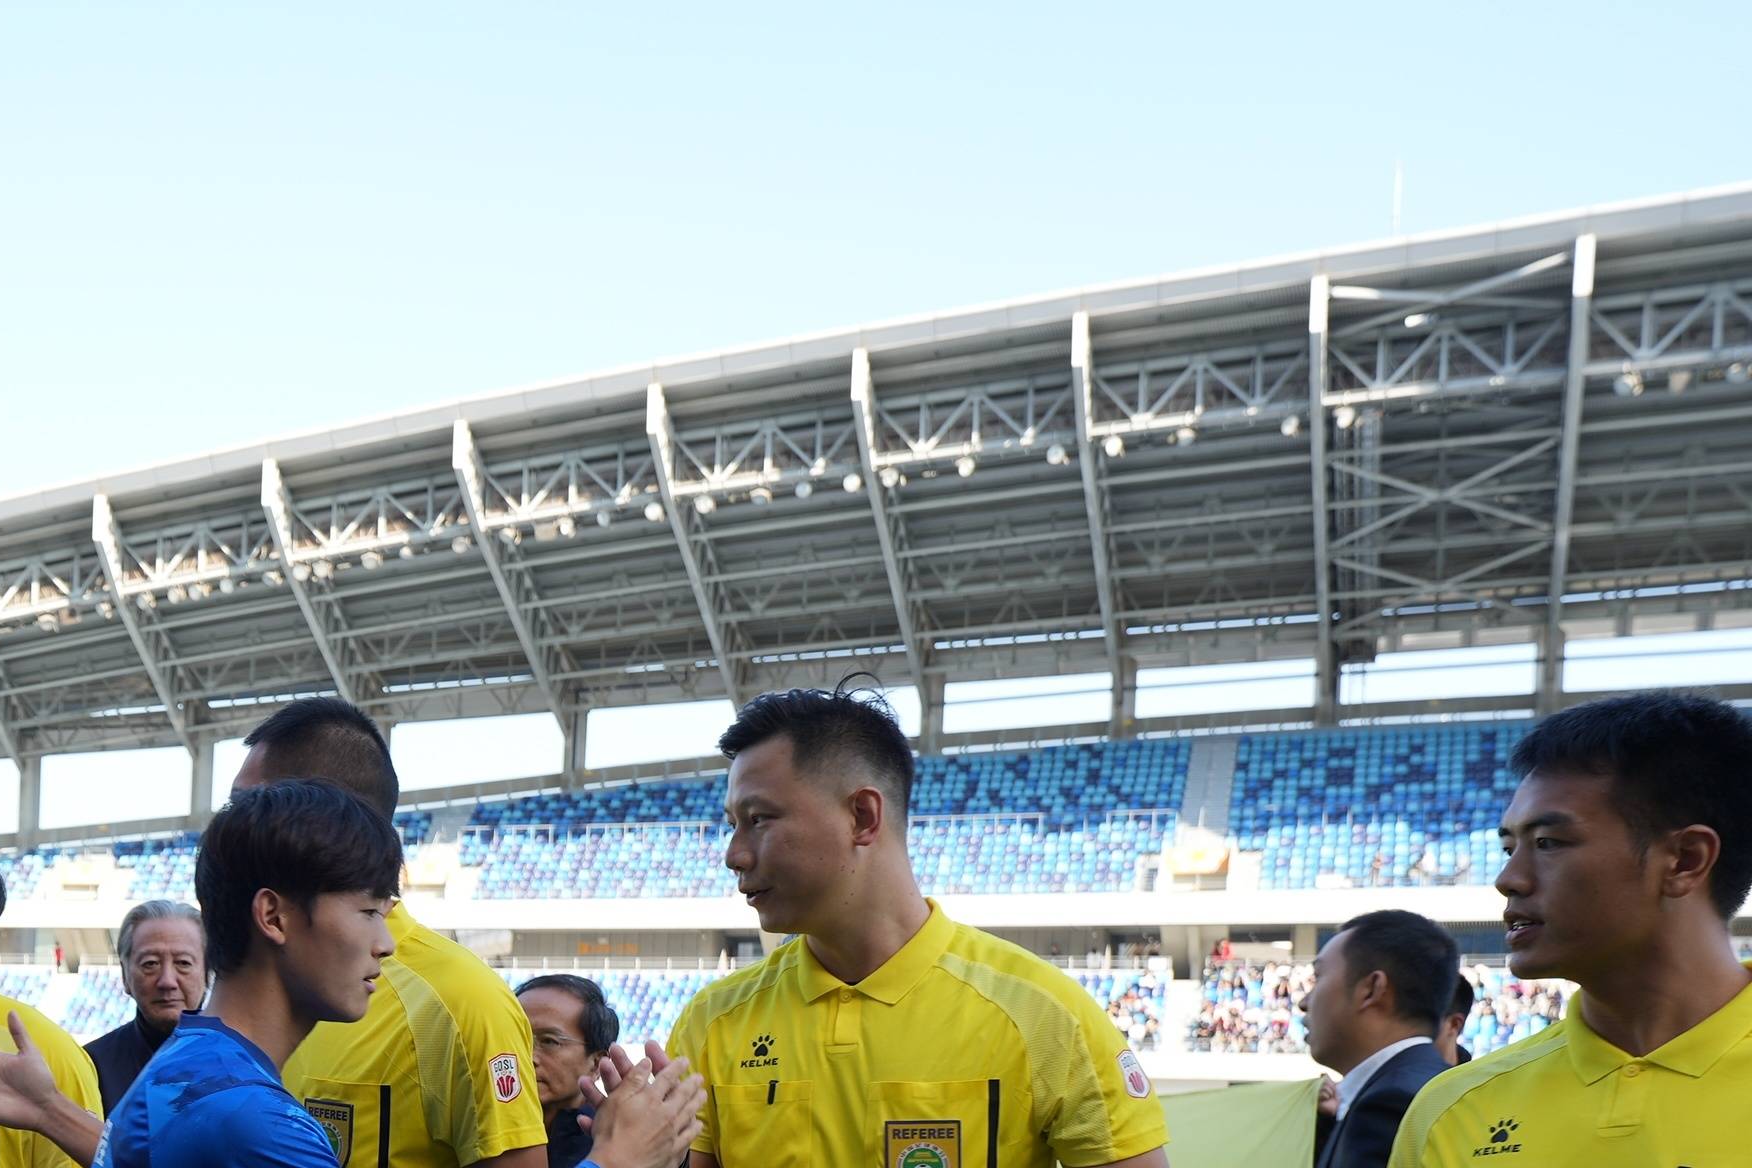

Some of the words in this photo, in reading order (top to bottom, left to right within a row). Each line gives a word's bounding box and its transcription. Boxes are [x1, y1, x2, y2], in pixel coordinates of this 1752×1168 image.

[740, 1058, 779, 1069] KELME
[309, 1108, 349, 1121] REFEREE
[891, 1127, 956, 1140] REFEREE
[1472, 1144, 1523, 1157] KELME
